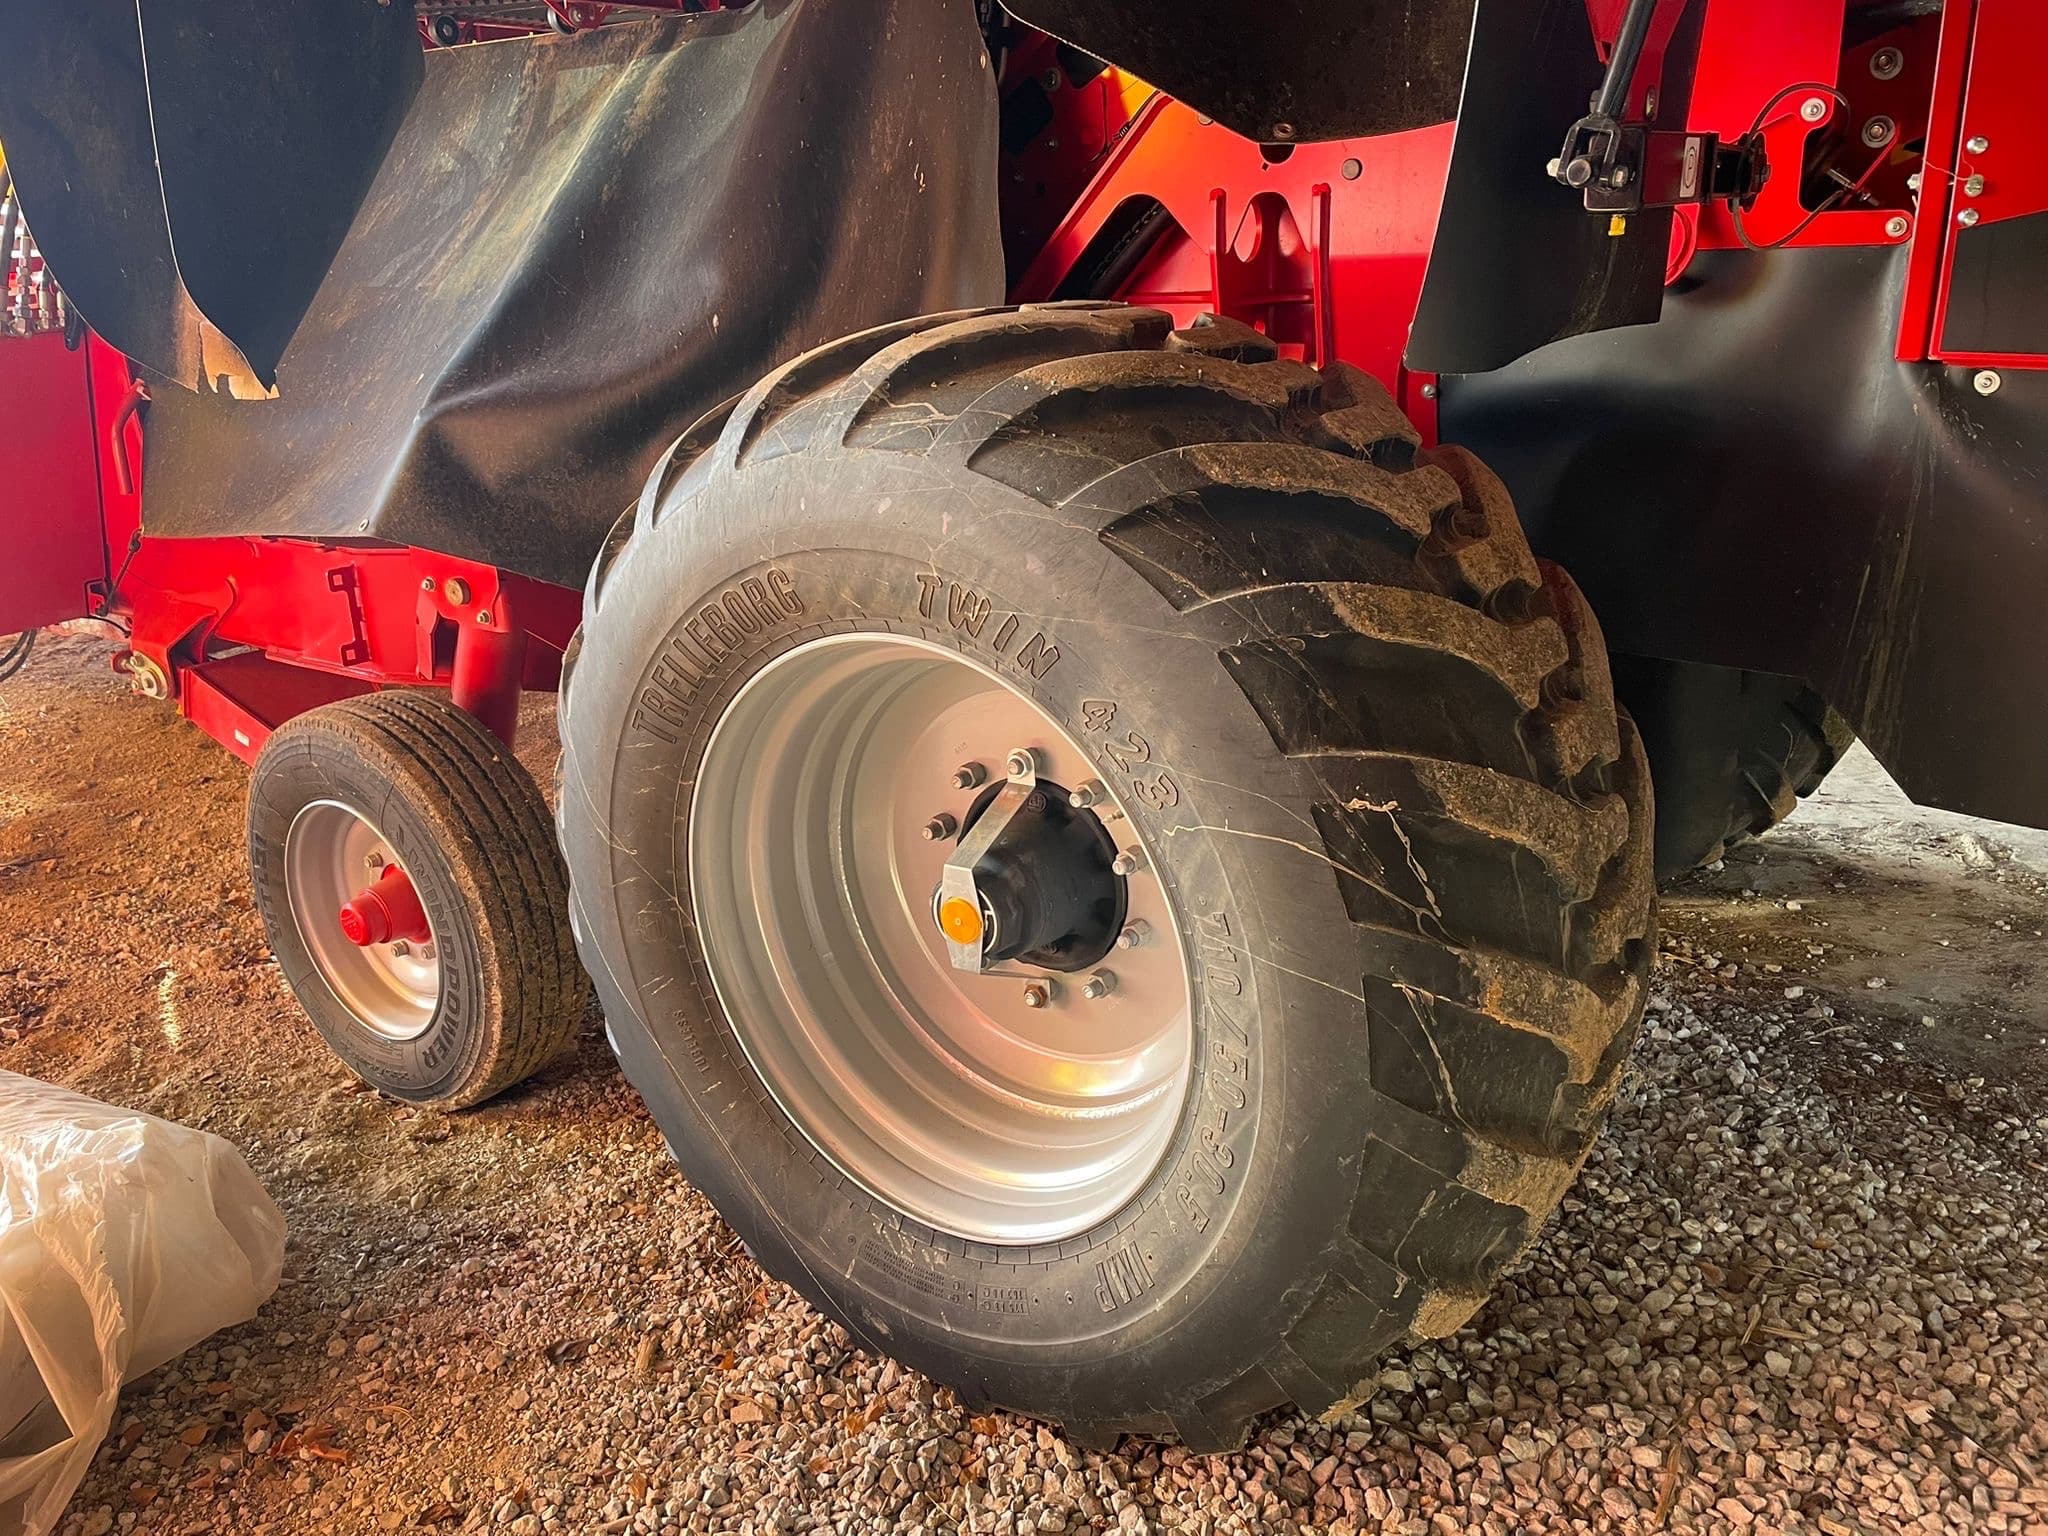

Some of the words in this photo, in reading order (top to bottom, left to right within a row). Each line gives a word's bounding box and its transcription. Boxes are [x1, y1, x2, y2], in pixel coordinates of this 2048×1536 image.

[631, 566, 805, 744] TRELLEBORG
[915, 572, 1062, 682] TWIN
[1082, 699, 1180, 811] 423
[407, 849, 463, 1070] WINDPOWER
[672, 1008, 711, 1076] TUBELESS
[1175, 911, 1249, 1234] 710/50-30.5
[1093, 1239, 1156, 1314] IMP
